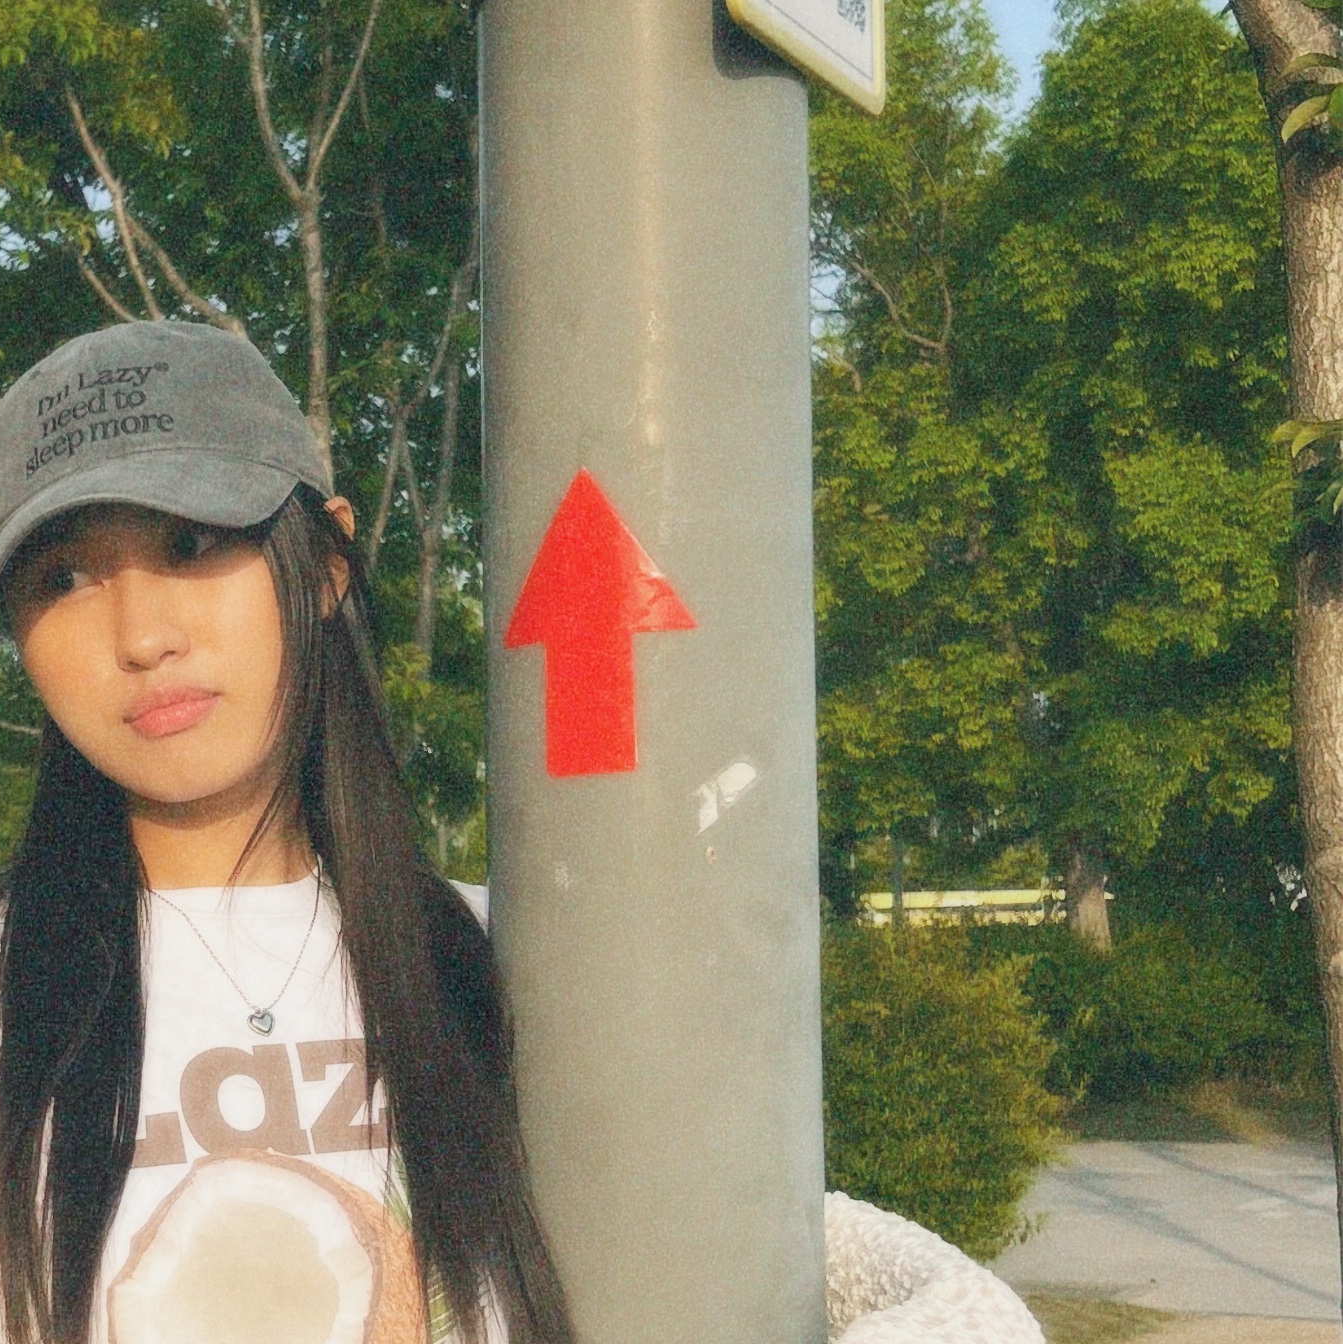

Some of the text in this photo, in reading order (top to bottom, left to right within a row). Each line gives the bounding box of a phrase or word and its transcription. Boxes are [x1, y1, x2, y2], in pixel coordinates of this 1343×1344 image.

[40, 387, 147, 439] need to
[25, 413, 175, 480] sleep more
